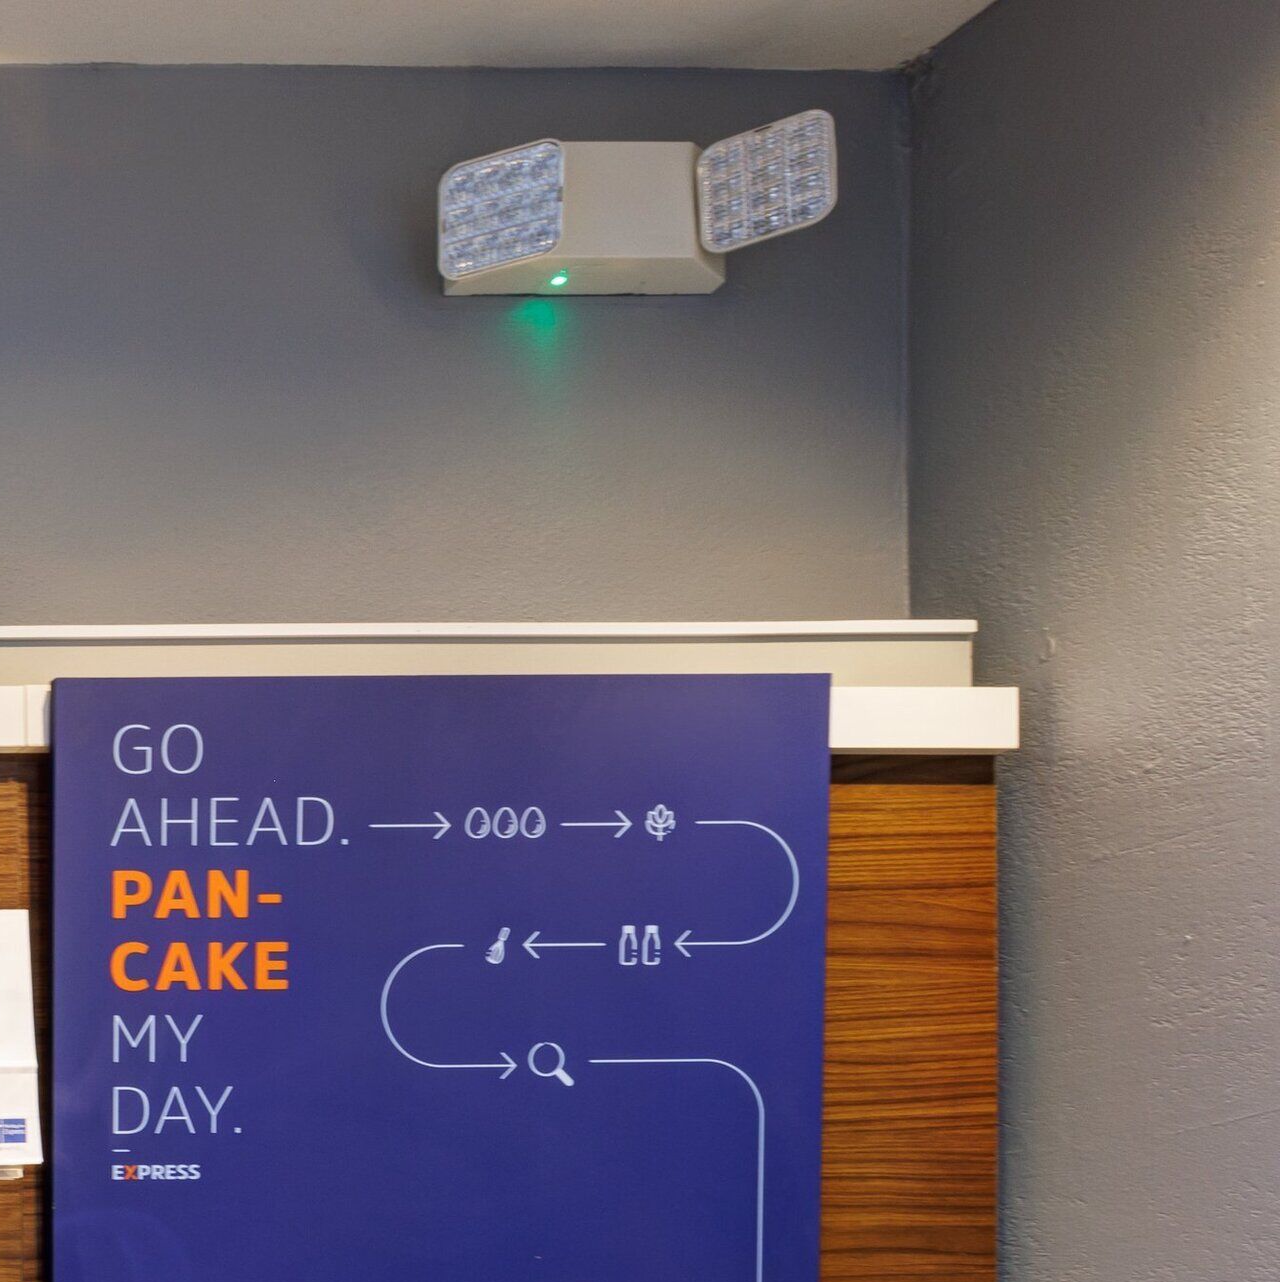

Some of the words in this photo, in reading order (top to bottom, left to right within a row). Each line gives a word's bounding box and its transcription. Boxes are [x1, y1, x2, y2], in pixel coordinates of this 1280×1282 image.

[111, 723, 205, 775] GO
[109, 796, 350, 847] AHEAD.
[111, 869, 283, 919] PAN-
[110, 941, 290, 991] CAKE
[111, 1014, 205, 1063] MY
[111, 1085, 243, 1135] DAY.
[111, 1163, 202, 1181] EXPRESS
